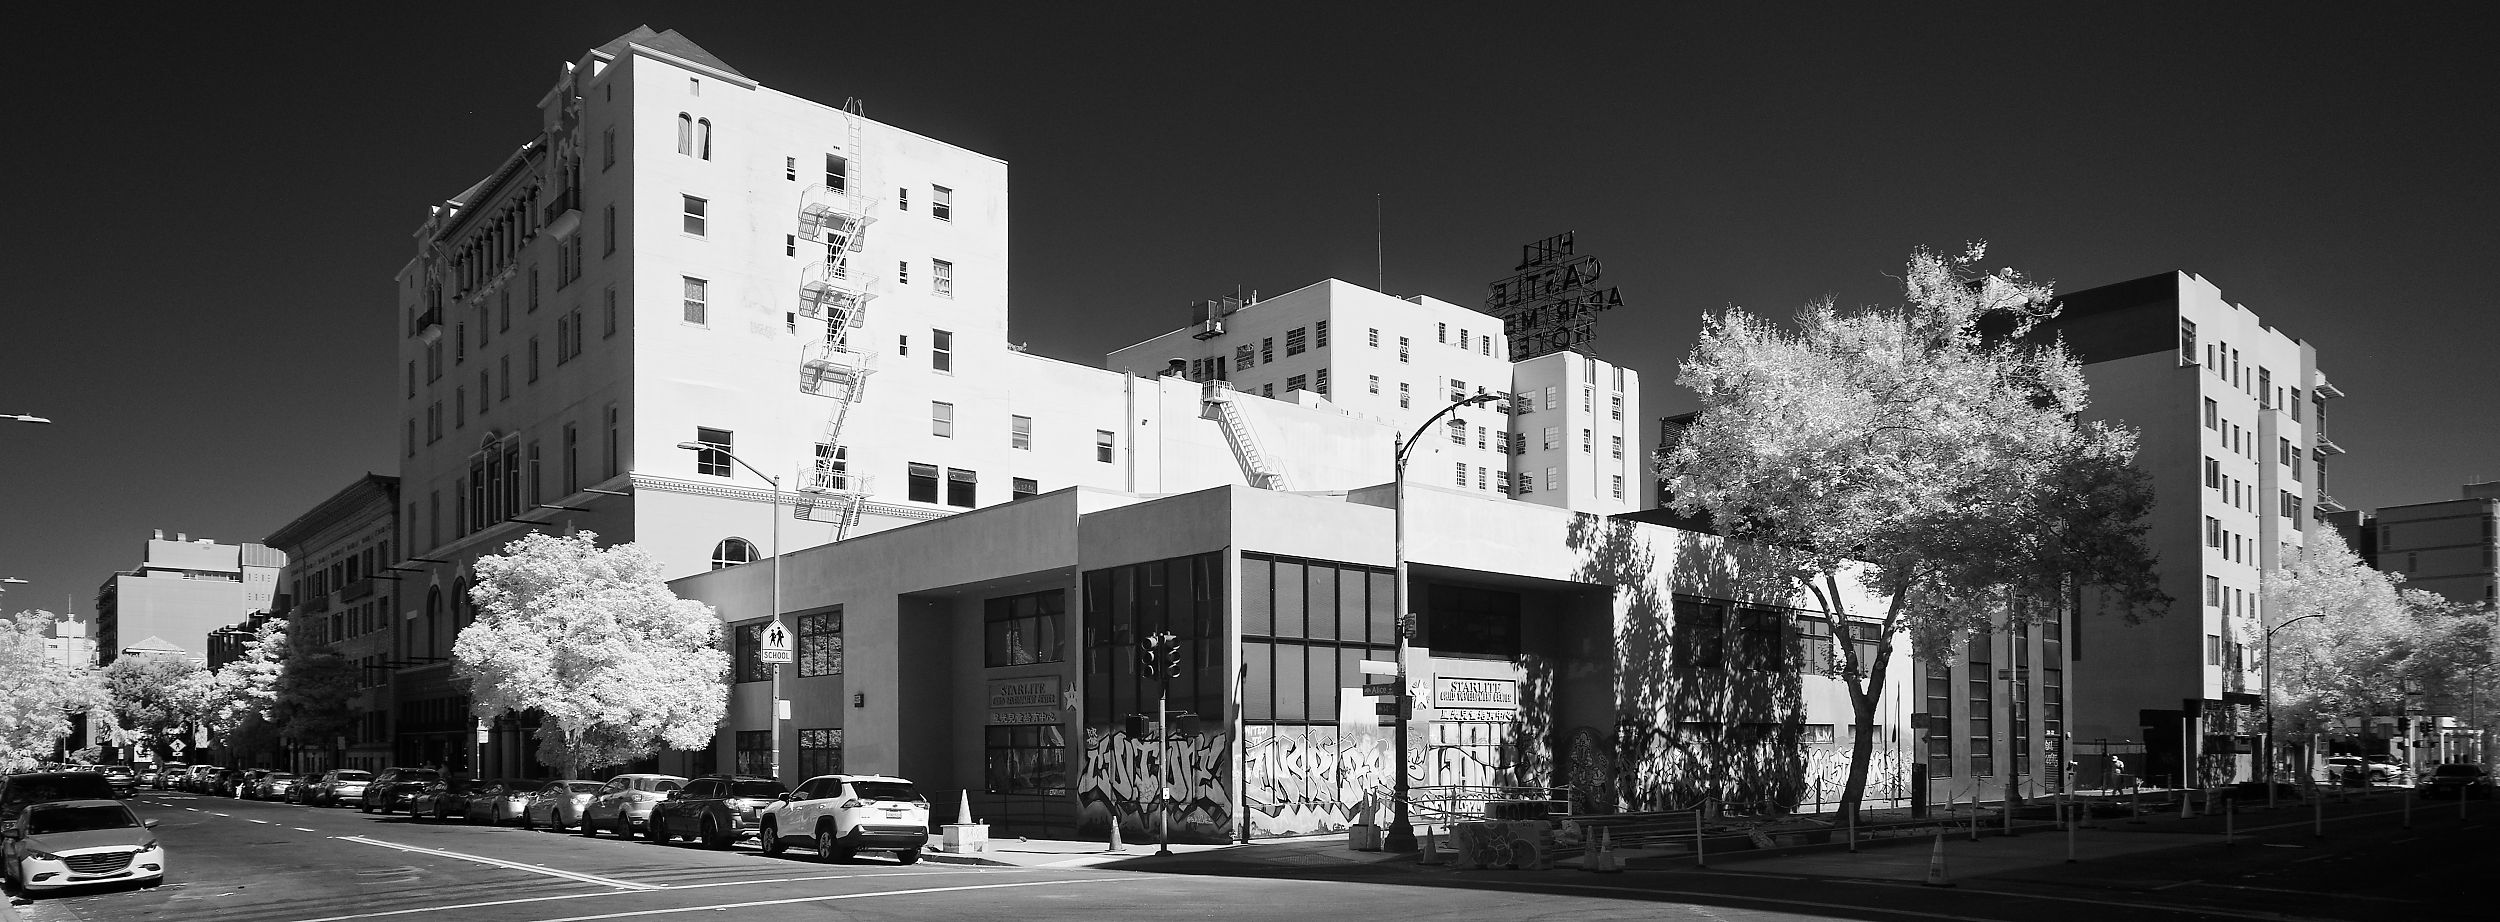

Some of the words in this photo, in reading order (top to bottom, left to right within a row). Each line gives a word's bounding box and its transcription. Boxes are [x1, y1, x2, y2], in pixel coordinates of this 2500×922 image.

[763, 651, 790, 660] SCHOOL
[1001, 682, 1045, 696] STARLITE
[1451, 681, 1503, 694] STARLITE
